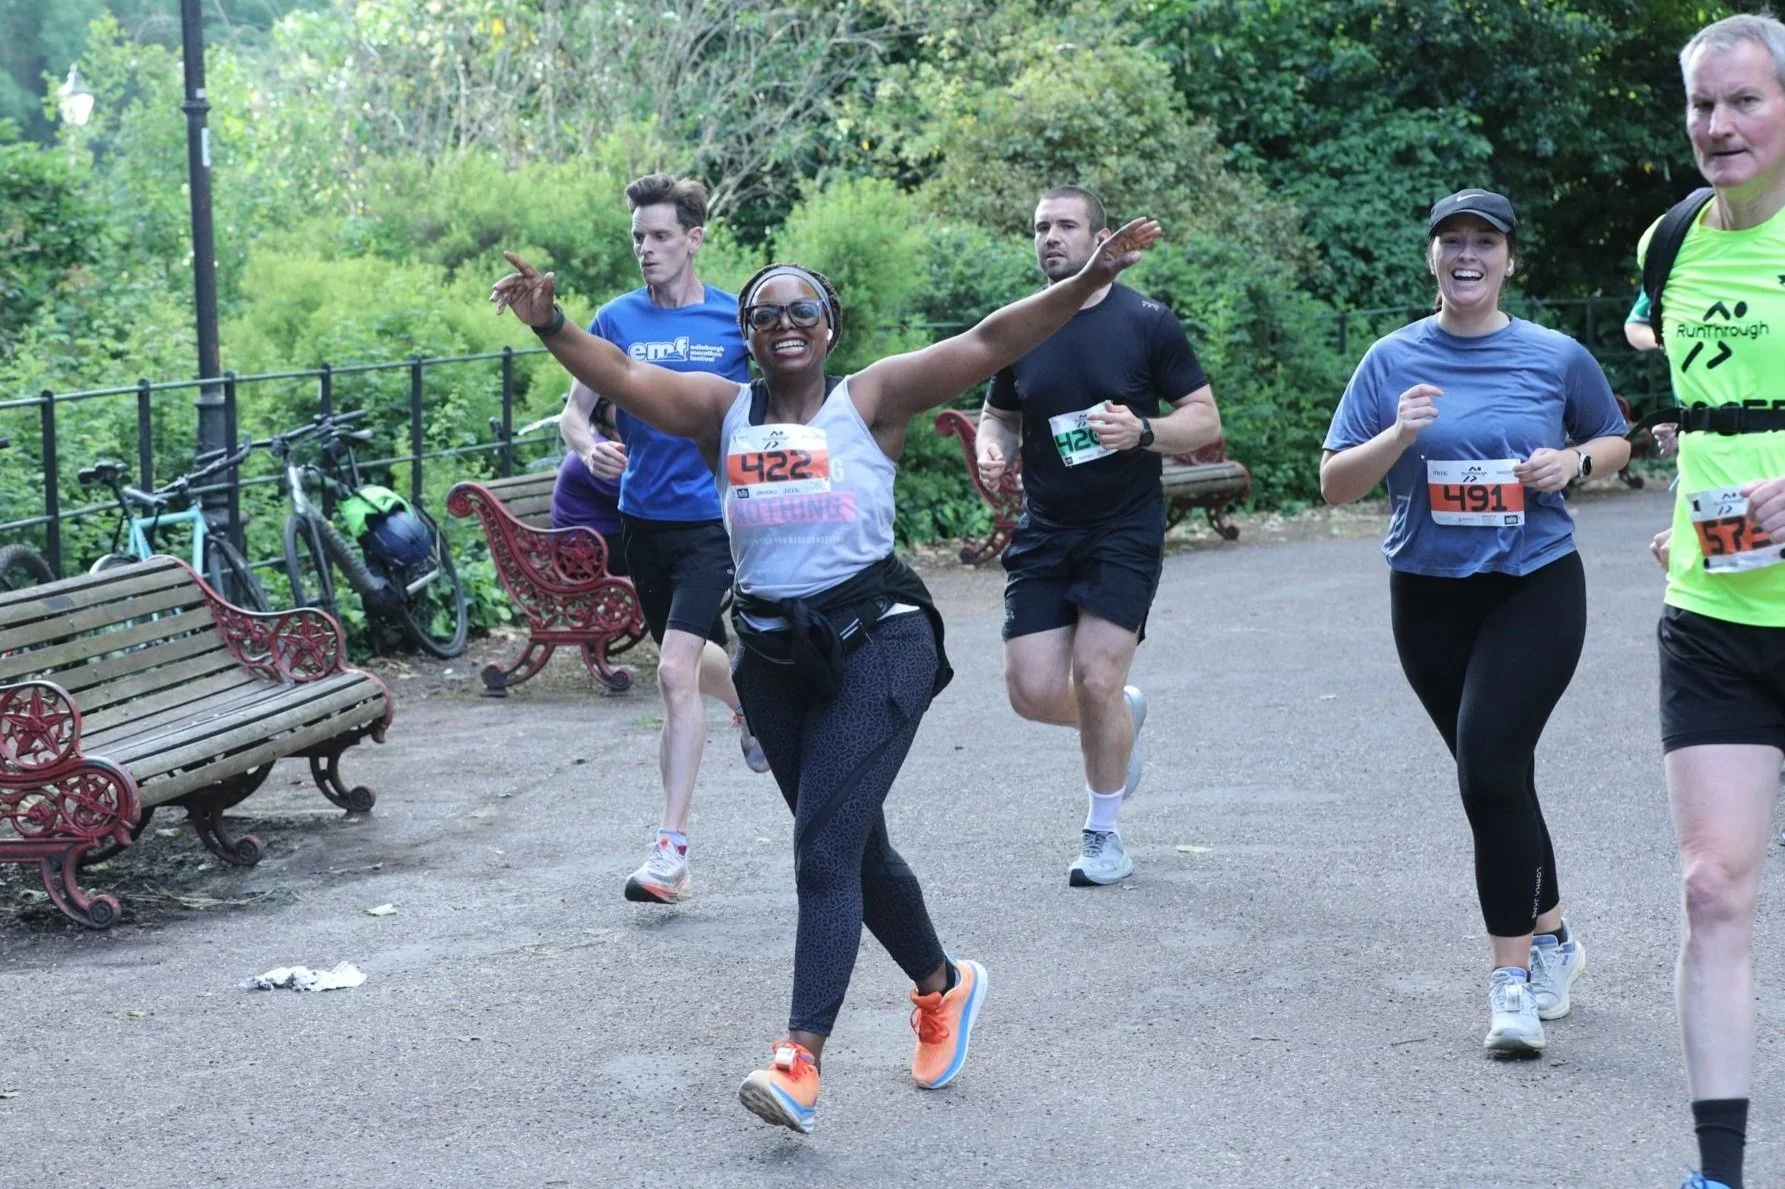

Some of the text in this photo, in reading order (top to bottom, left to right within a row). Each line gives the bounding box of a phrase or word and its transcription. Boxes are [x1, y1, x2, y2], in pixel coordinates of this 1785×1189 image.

[1676, 321, 1770, 340] RunThrough
[627, 336, 689, 361] emf
[741, 449, 812, 482] 422
[1443, 485, 1508, 512] 491
